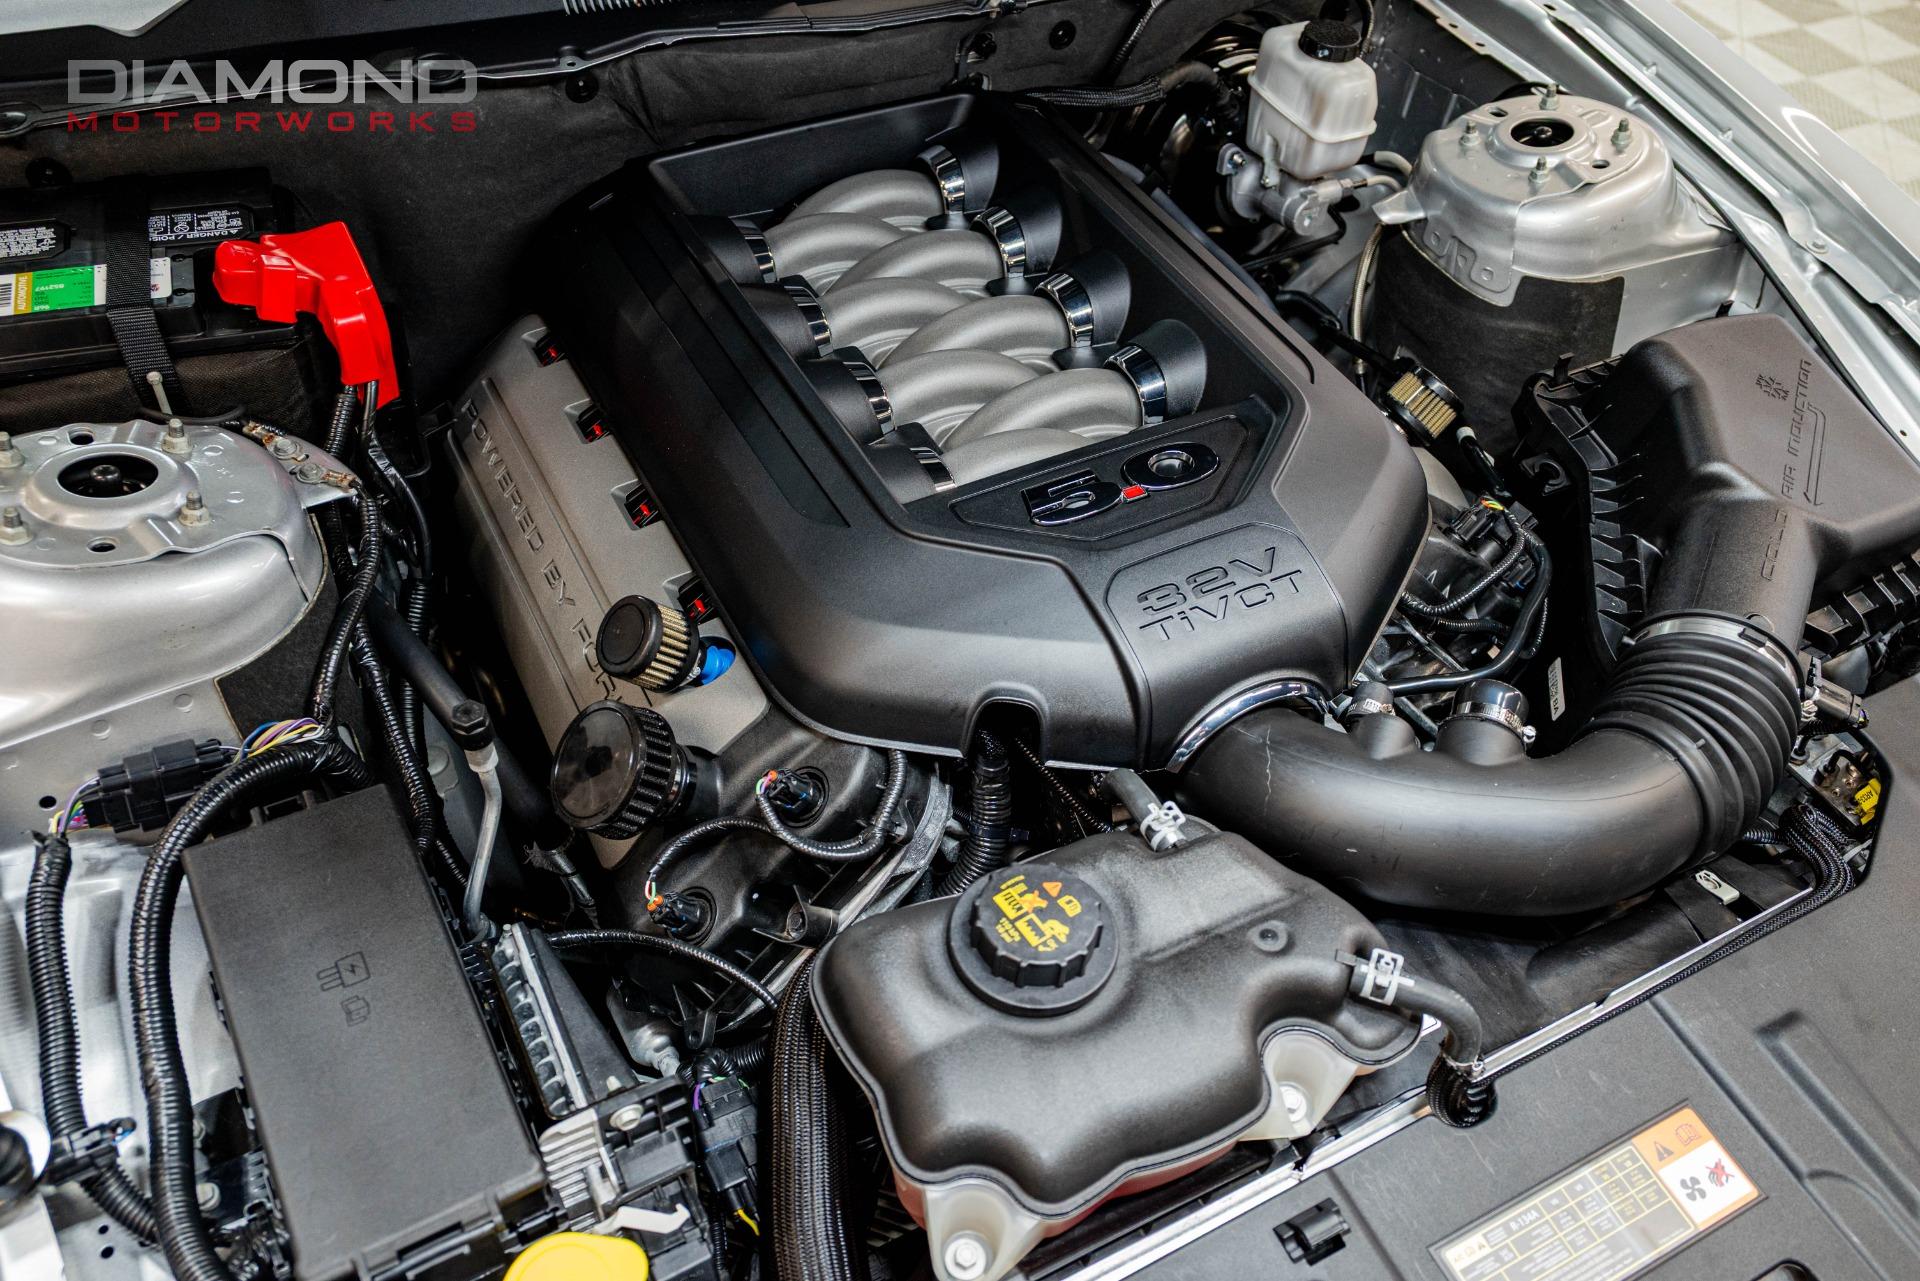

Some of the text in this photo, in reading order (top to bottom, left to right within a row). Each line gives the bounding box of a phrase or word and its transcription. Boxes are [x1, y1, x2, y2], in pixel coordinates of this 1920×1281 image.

[148, 234, 175, 242] POIS
[1787, 359, 1813, 457] INDUCTION
[461, 398, 544, 552] POWERED
[540, 559, 576, 608] BY
[1020, 441, 1220, 527] 5.0
[1781, 463, 1797, 499] AIR
[1137, 545, 1277, 617] 32V
